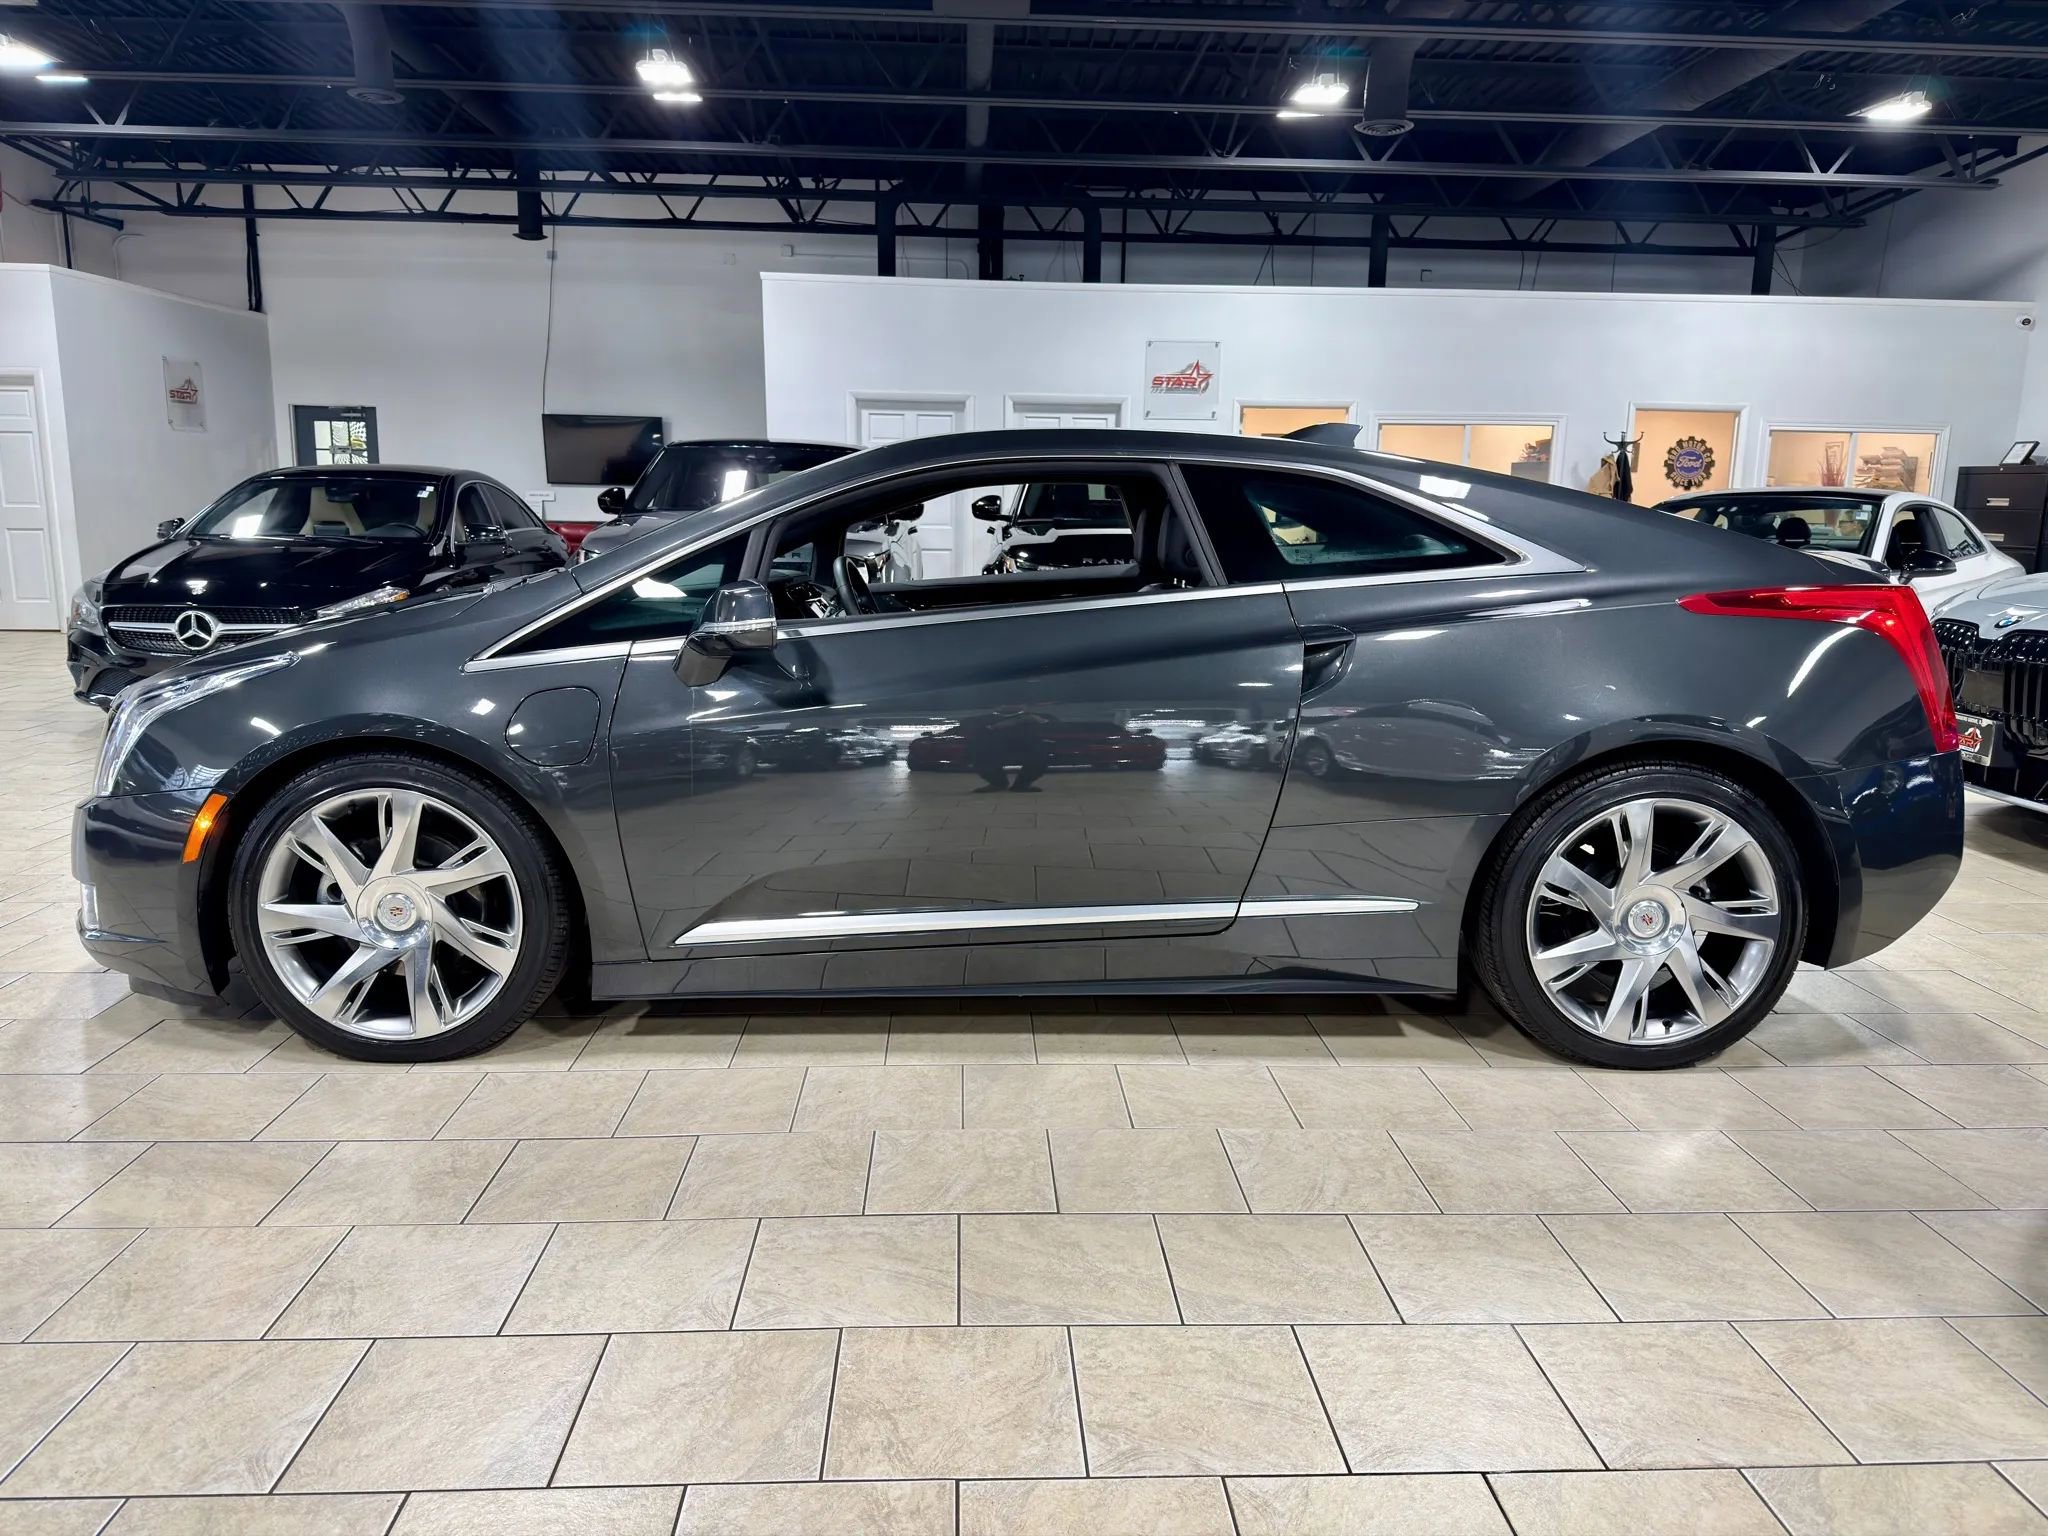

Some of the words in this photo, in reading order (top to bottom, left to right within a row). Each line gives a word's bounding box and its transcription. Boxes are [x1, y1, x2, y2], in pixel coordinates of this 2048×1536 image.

[1152, 376, 1198, 387] STAR
[1667, 447, 1681, 465] FORD
[1682, 440, 1706, 452] MOTOR
[1676, 455, 1702, 468] Ford
[1669, 471, 1689, 486] SINCE
